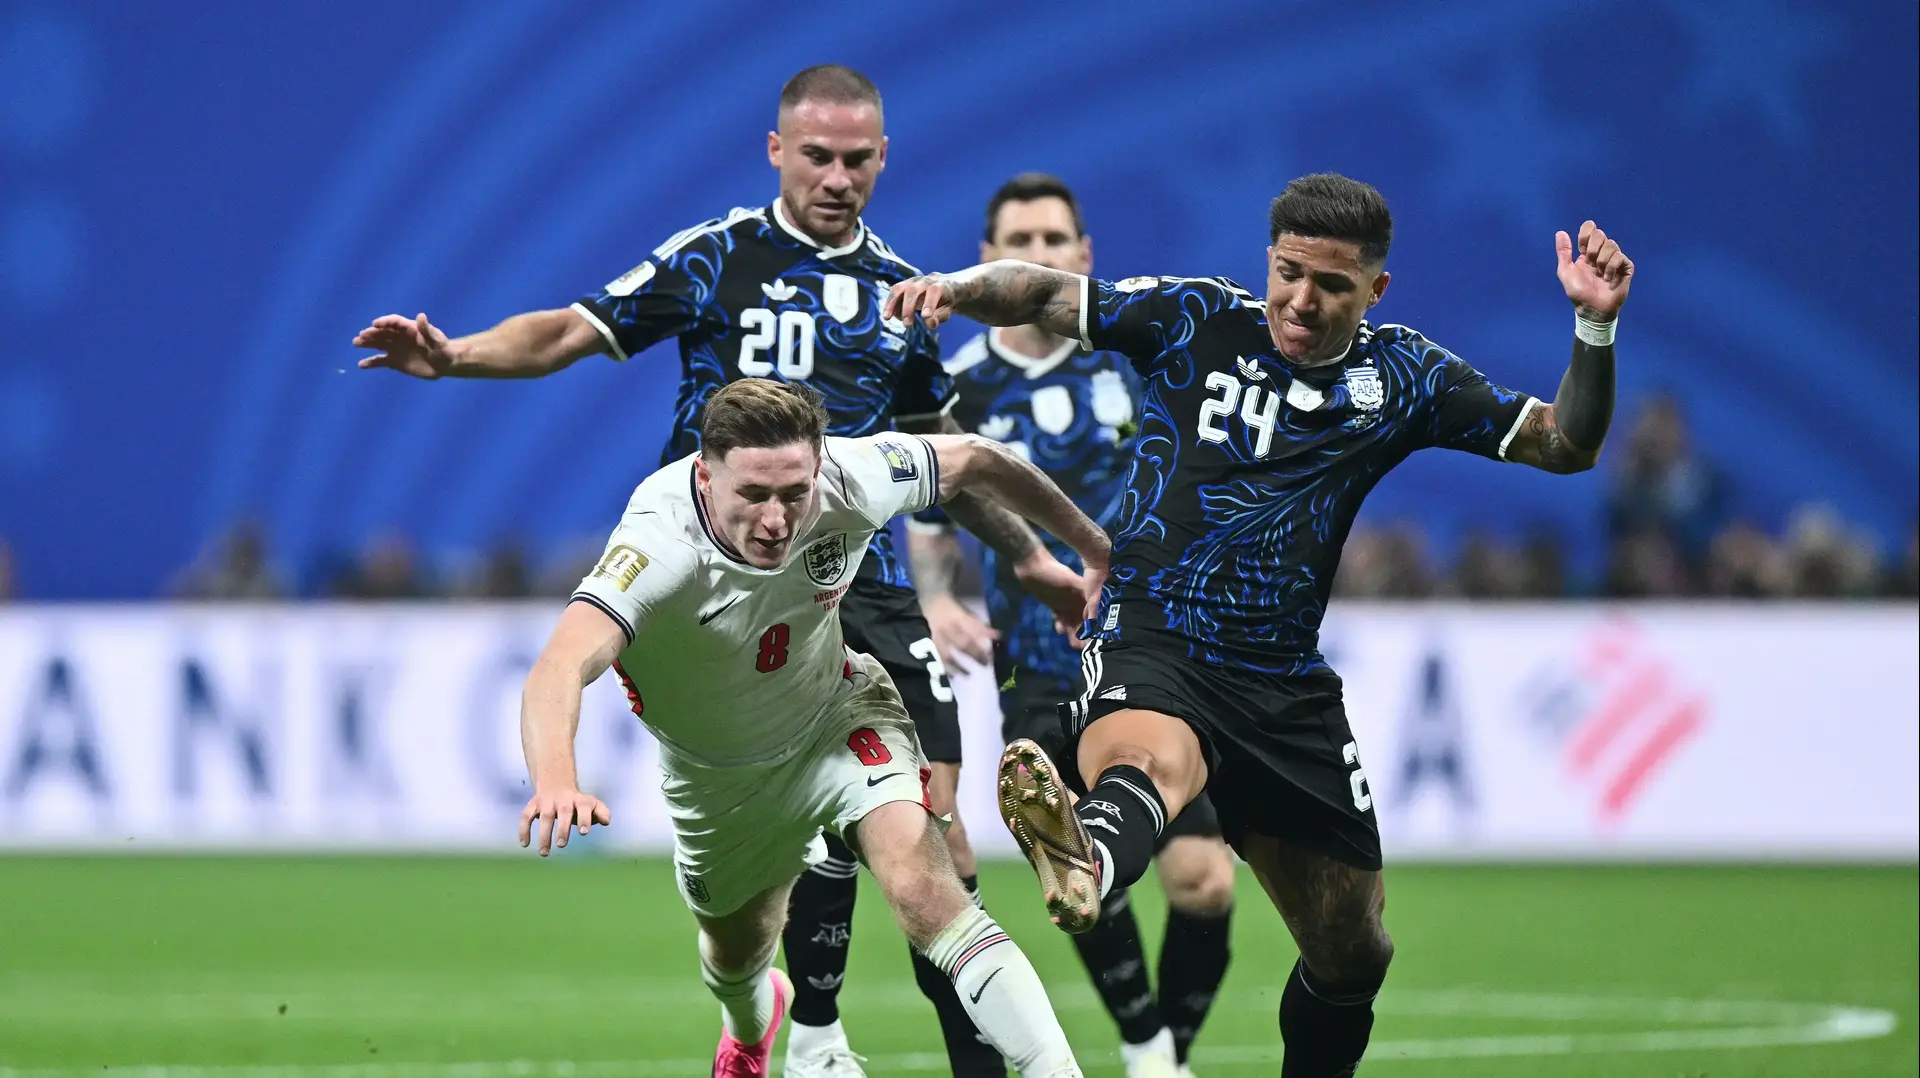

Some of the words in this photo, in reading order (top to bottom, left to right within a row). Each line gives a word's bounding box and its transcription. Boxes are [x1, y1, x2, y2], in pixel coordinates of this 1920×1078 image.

[738, 308, 814, 380] 20
[1197, 371, 1281, 458] 24
[1357, 379, 1377, 398] AFA
[755, 622, 790, 673] 8
[909, 636, 953, 702] 2
[847, 727, 892, 766] 8
[1342, 740, 1371, 812] 2
